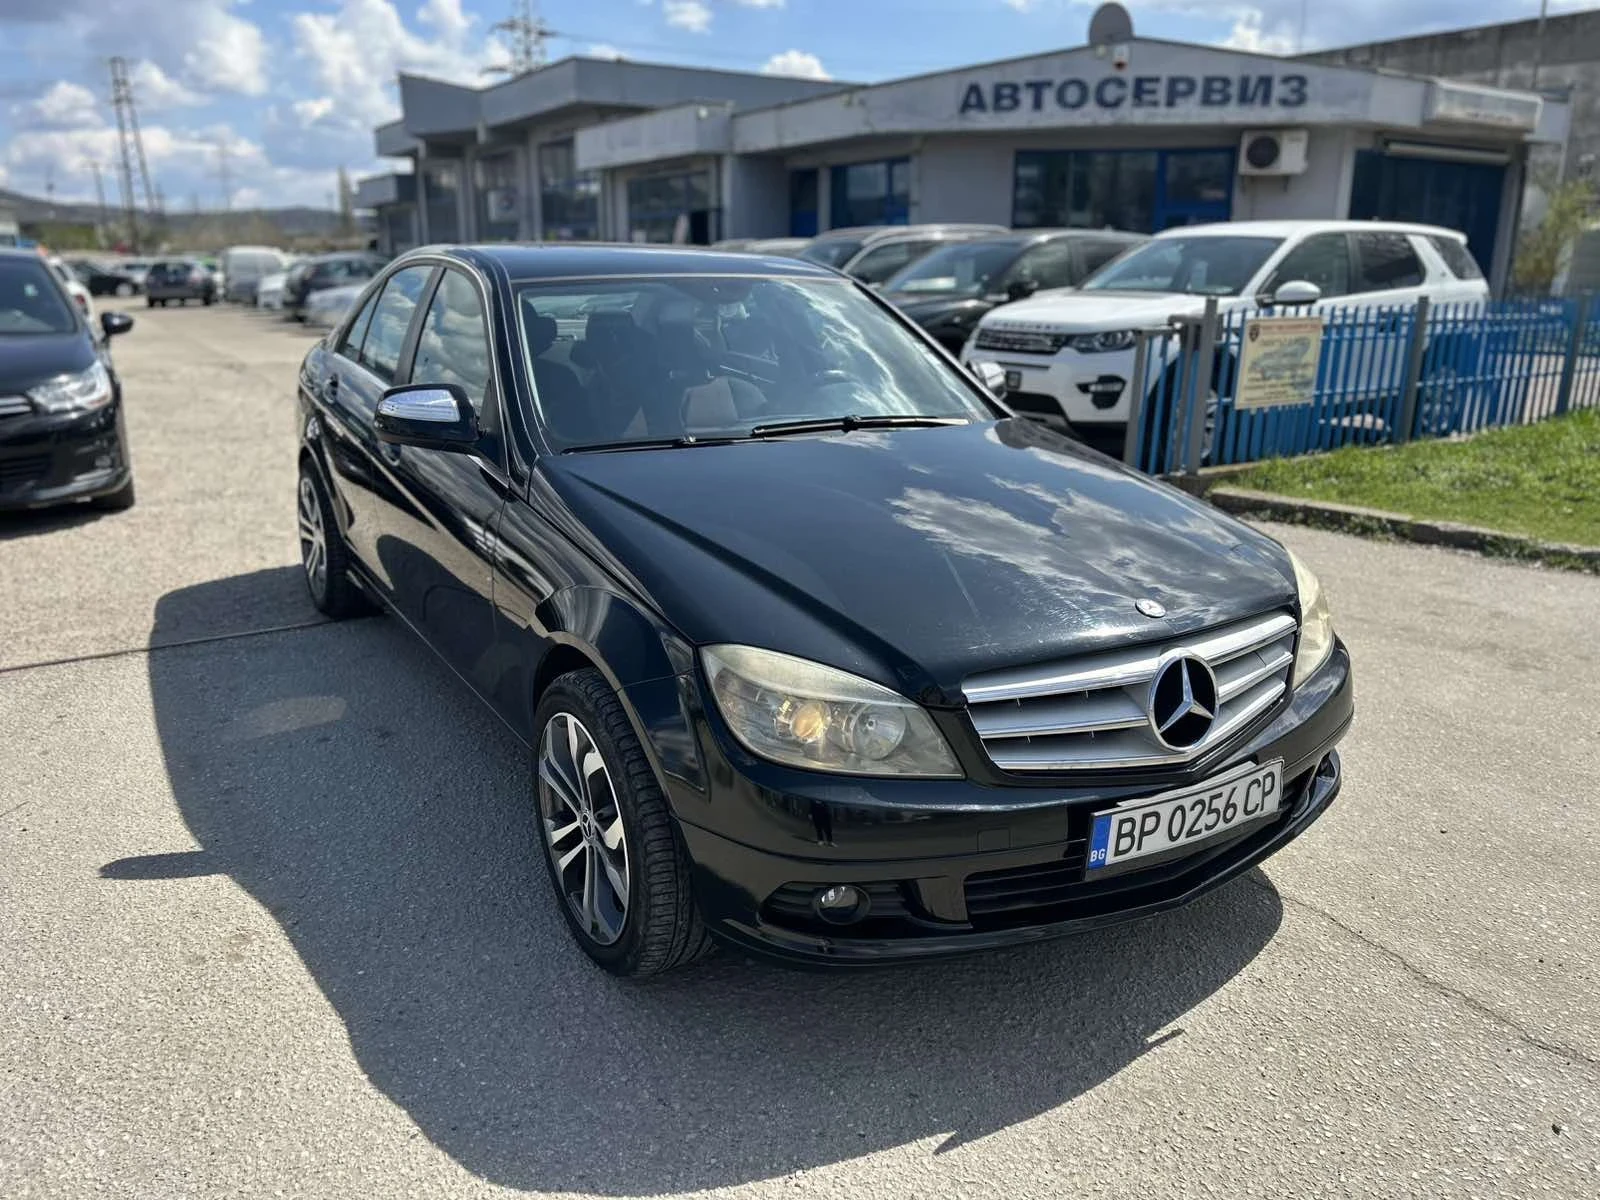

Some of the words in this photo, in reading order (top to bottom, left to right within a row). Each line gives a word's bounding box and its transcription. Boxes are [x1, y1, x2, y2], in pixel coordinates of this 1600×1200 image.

[959, 74, 1309, 114] АВТОСЕРВИЗ
[1114, 811, 1160, 857] BP
[1167, 786, 1238, 843] 0256
[1242, 771, 1276, 816] CP
[1089, 848, 1106, 863] BG
